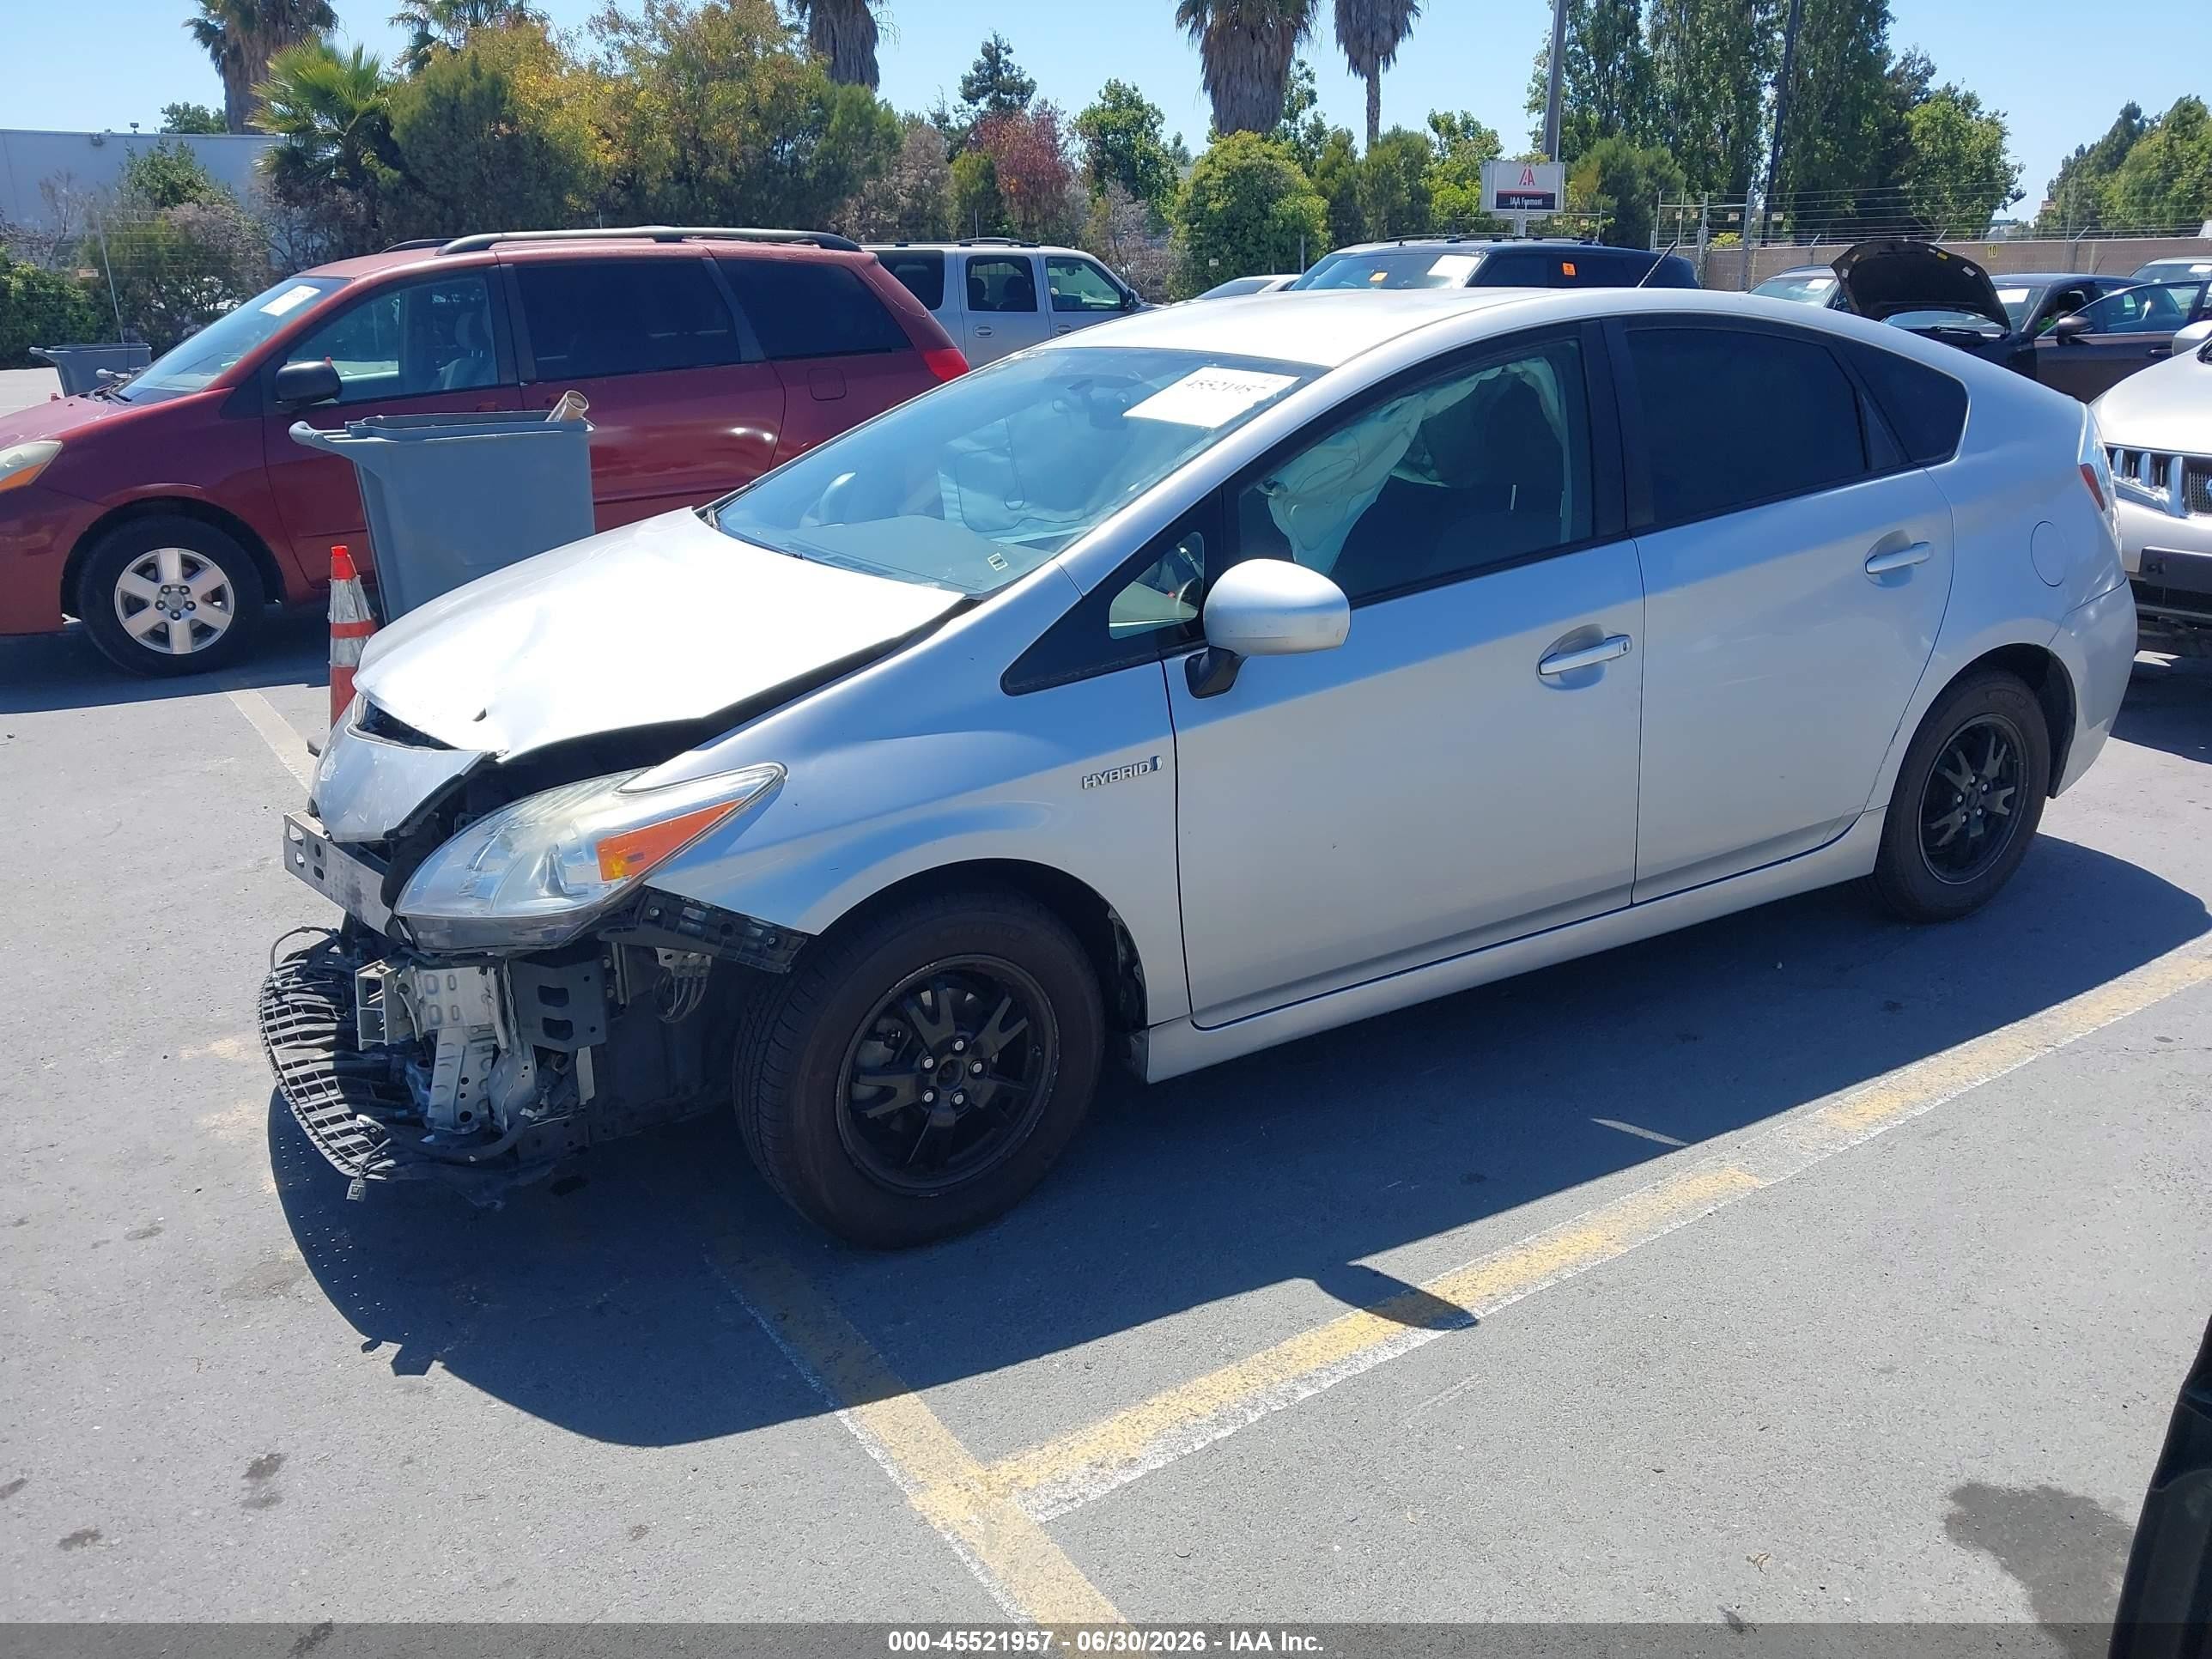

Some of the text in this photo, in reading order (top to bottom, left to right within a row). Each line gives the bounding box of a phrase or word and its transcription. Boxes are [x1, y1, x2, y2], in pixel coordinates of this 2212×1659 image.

[1510, 196, 1520, 206] IAA
[1989, 245, 1996, 257] 10
[1082, 761, 1151, 789] HYBRID
